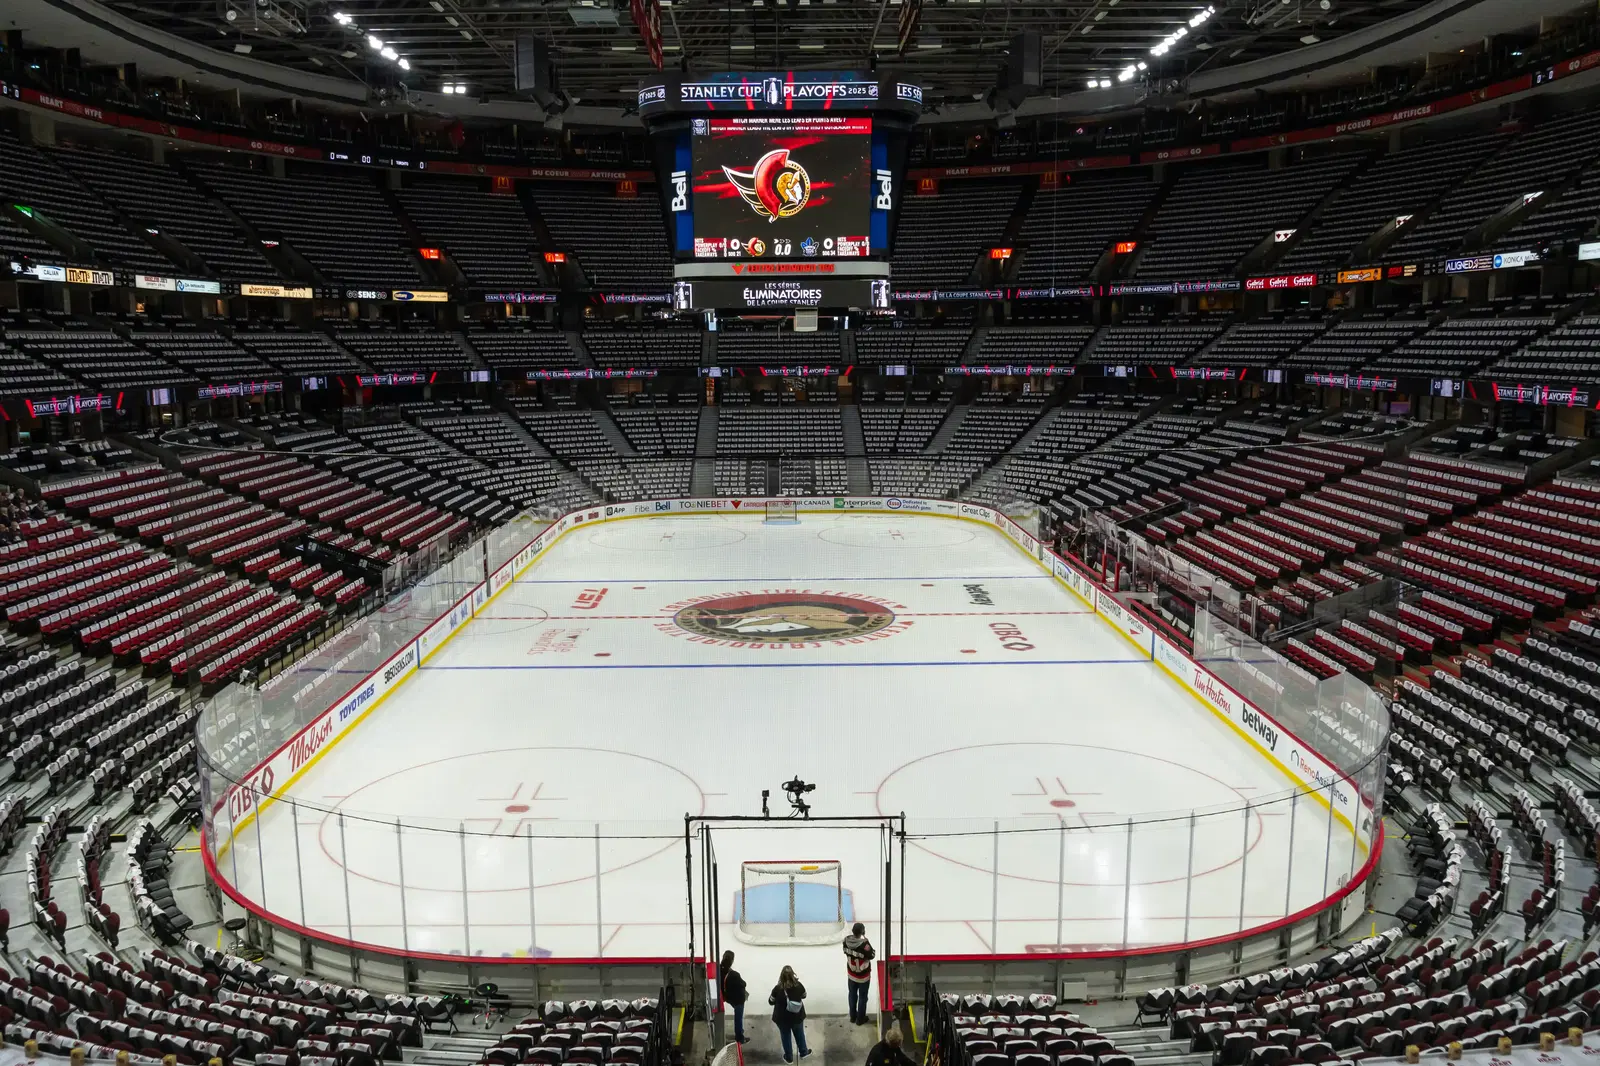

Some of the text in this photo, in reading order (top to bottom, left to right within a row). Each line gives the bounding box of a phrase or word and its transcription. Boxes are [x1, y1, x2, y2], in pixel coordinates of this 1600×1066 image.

[645, 91, 656, 100] 2025
[681, 86, 735, 98] STANLEY
[738, 86, 761, 97] CUP
[783, 84, 846, 97] PLAYOFFS
[897, 85, 912, 97] LES
[40, 95, 64, 108] HEART
[84, 107, 102, 119] HYPE
[1336, 124, 1347, 133] DU
[1347, 120, 1371, 130] COEUR
[1393, 106, 1431, 122] ARTIFICES
[251, 142, 263, 150] GO
[284, 146, 295, 154] GO
[1158, 151, 1169, 159] GO
[1190, 147, 1202, 155] GO
[330, 152, 335, 160] 0
[946, 168, 969, 176] HEART
[671, 170, 687, 211] Bell
[876, 169, 892, 211] Bell
[730, 238, 740, 250] 0
[774, 243, 792, 256] 0.0
[823, 238, 834, 250] 0
[1504, 256, 1524, 264] KONICA
[1246, 279, 1264, 288] Gabriel
[1269, 277, 1288, 286] Gabriel
[1293, 276, 1313, 284] Gabriel
[358, 290, 376, 299] SENS
[743, 288, 822, 300] ÉLIMINATOIRES
[1137, 285, 1172, 293] ÉLIMINATOIRES
[1370, 380, 1387, 388] STANLEY
[1454, 382, 1460, 390] 25
[1498, 388, 1572, 401] STANLEY CUP PLAYOFFS
[33, 398, 100, 413] STANLEY CUP PLAYOFFS
[634, 501, 671, 512] Fibe Bell
[962, 505, 979, 514] Great
[979, 508, 991, 518] Clips
[530, 538, 543, 558] FACES
[660, 590, 753, 612] CANADIAN
[1194, 668, 1231, 714] Tim Hortons
[339, 682, 375, 722] TOYO TIRES
[1242, 703, 1278, 751] betway
[288, 716, 332, 772] Molson
